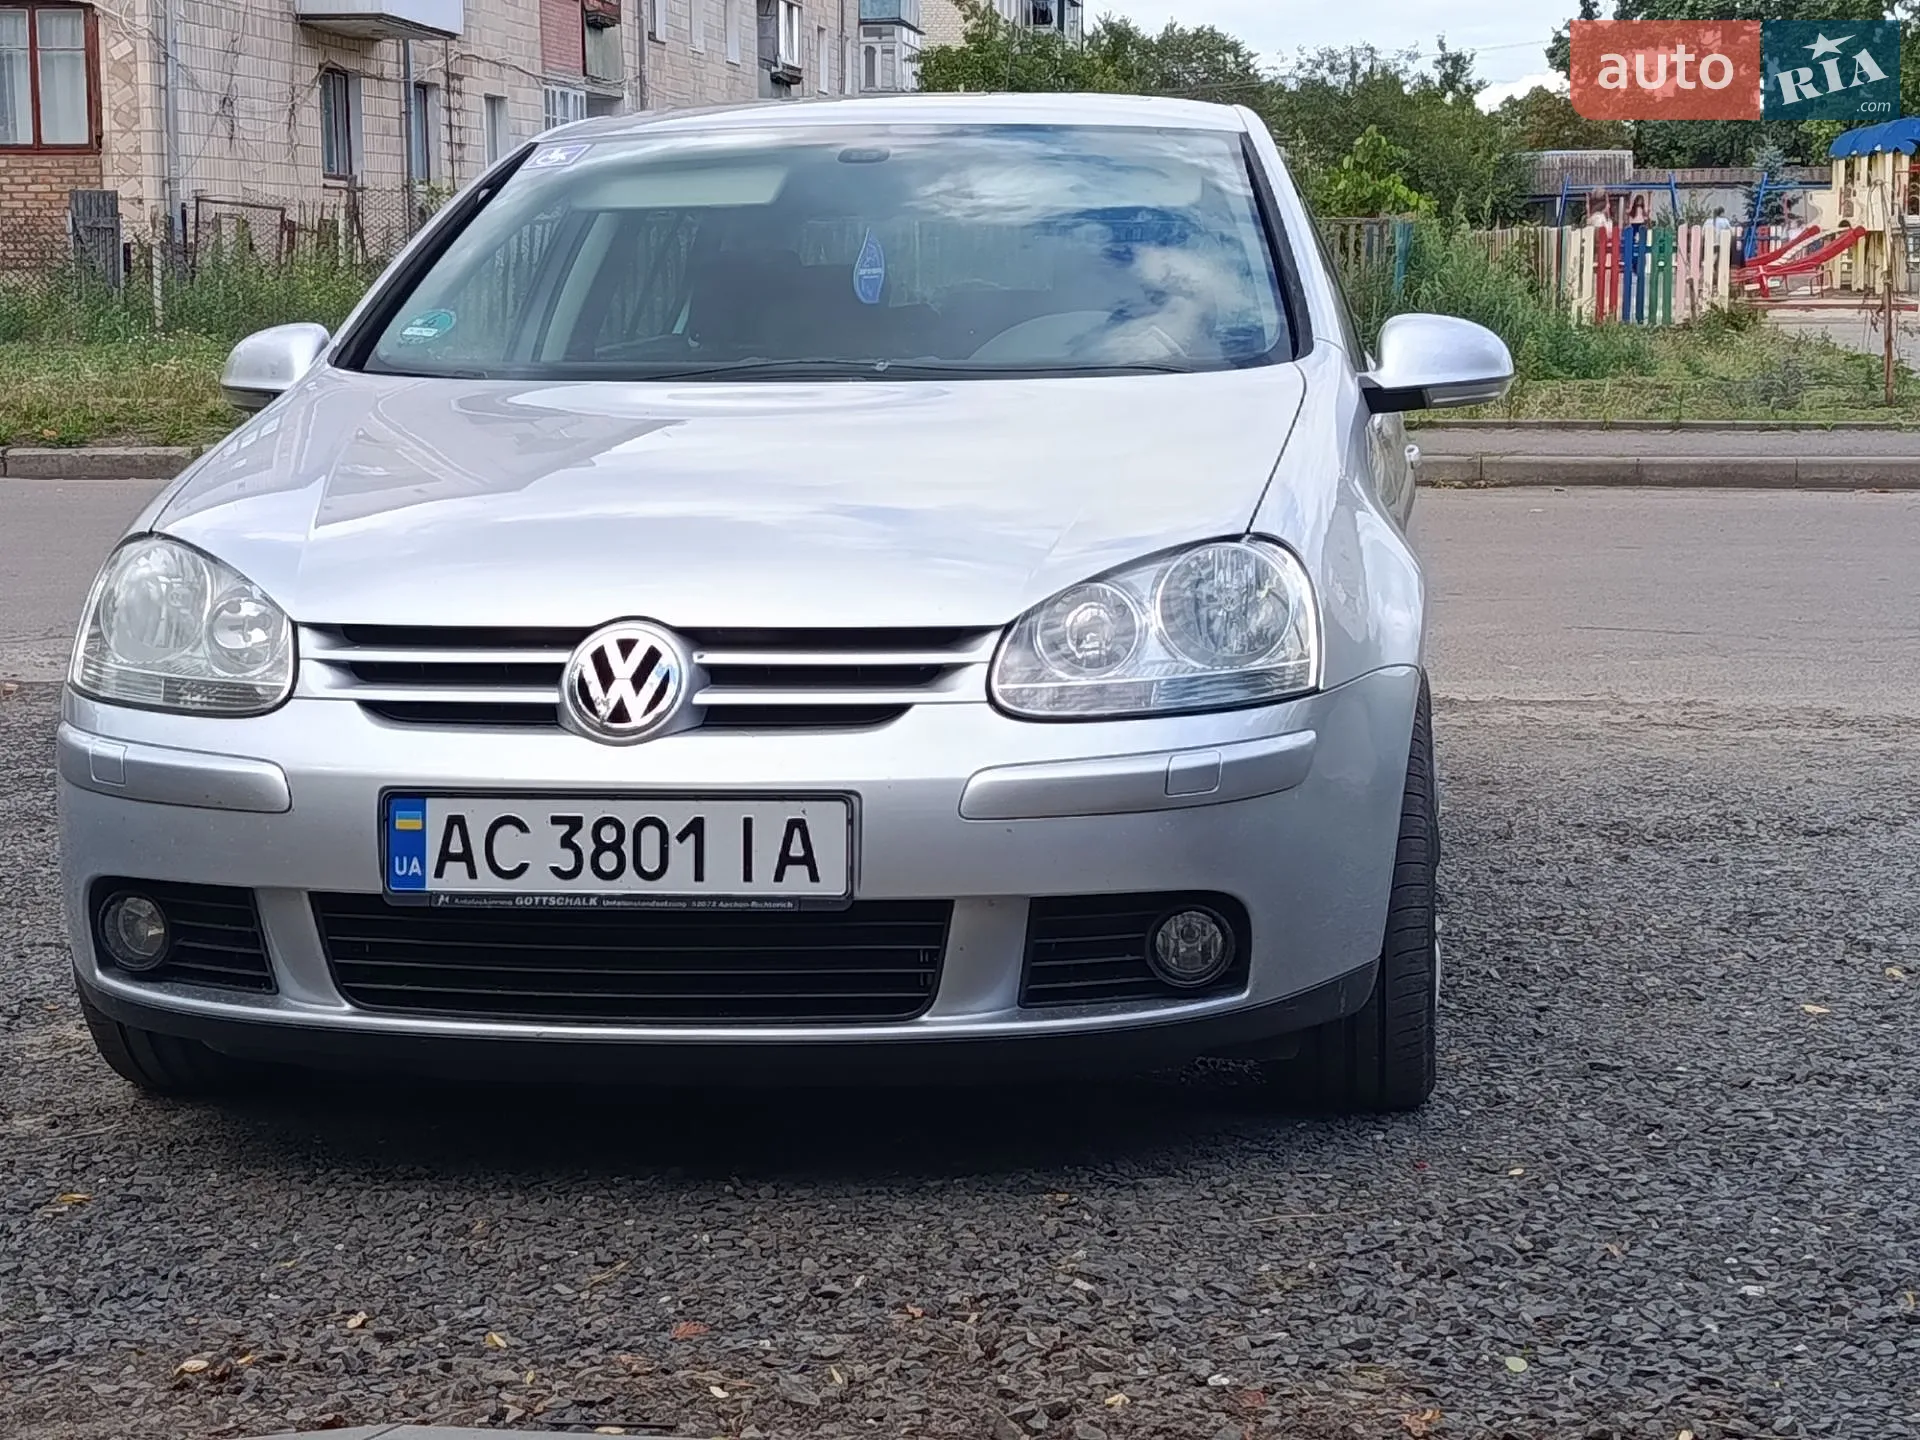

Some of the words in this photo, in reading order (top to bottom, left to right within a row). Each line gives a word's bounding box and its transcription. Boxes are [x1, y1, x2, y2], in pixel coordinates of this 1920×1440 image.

[433, 814, 532, 881] AC
[549, 815, 705, 883] 3801
[742, 816, 821, 884] IA
[394, 855, 422, 876] UA
[515, 896, 598, 906] GOTTSCHALK
